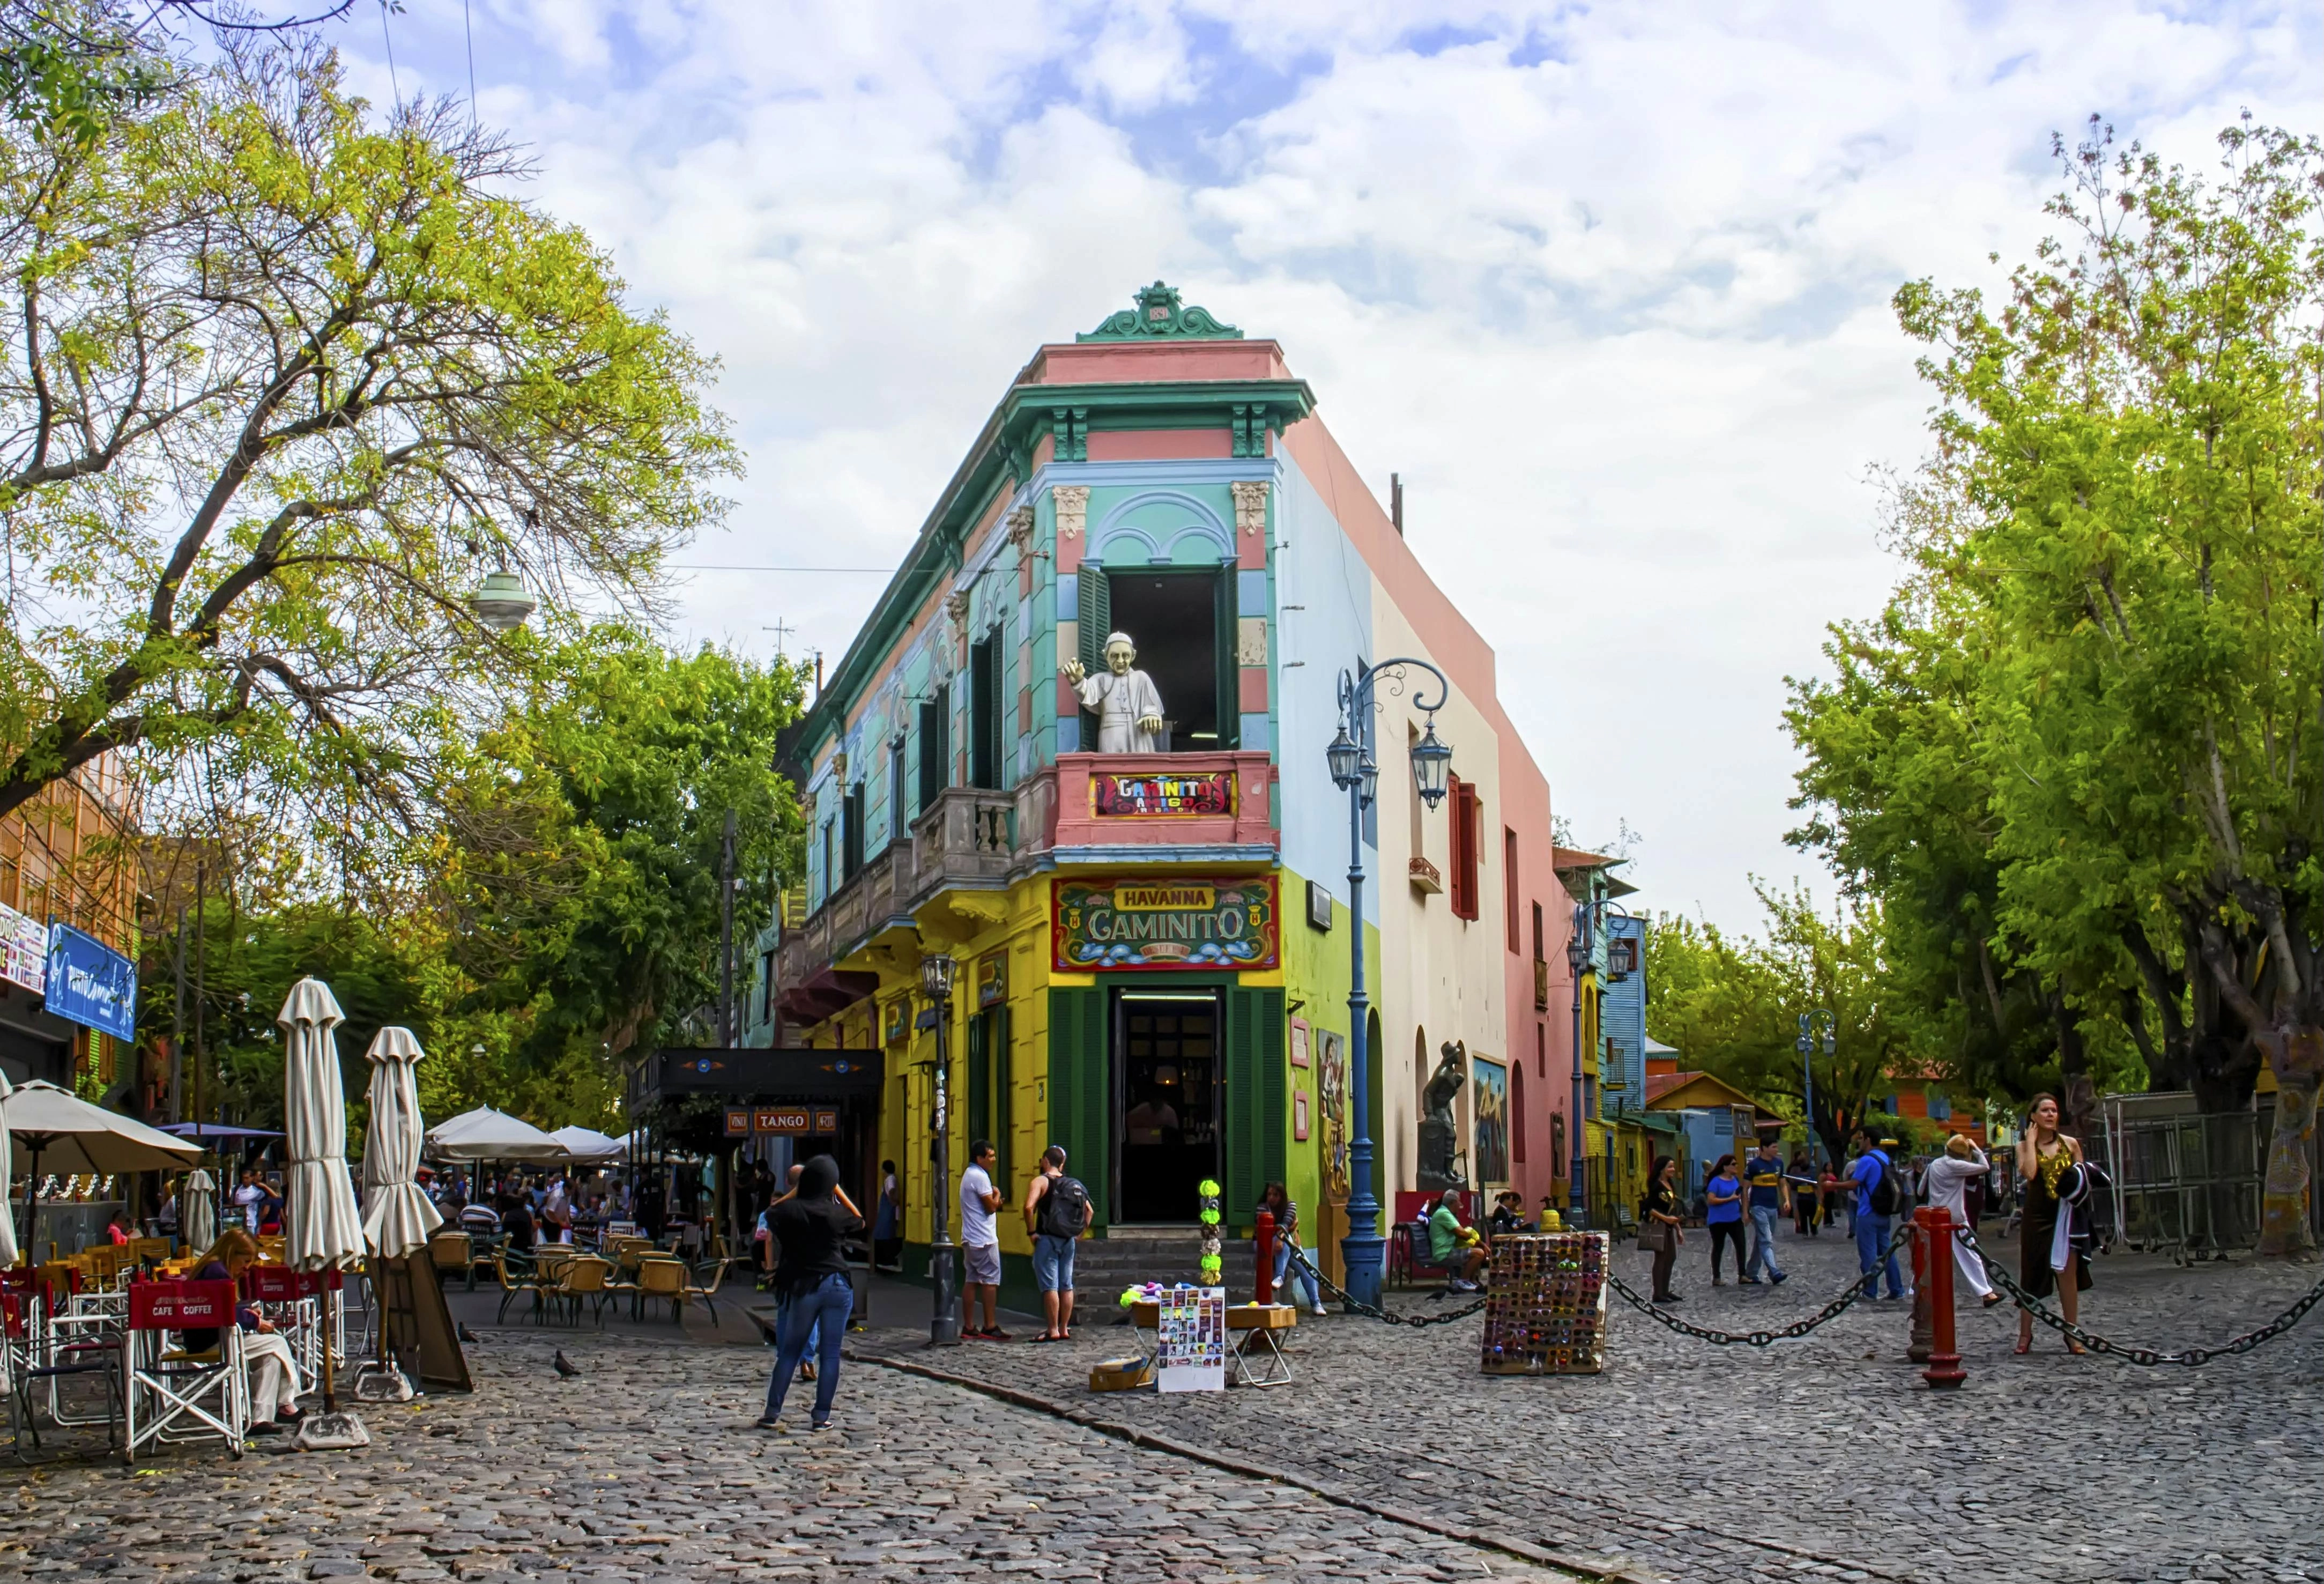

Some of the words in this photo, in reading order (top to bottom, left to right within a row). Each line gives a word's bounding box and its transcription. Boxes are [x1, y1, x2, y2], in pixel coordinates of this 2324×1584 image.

[1119, 779, 1212, 797] CAMINITO
[1137, 797, 1194, 808] AMIGO
[1124, 890, 1207, 906] HAVANNA
[1088, 908, 1244, 941] CAMINITO
[761, 1116, 804, 1128] TANGO
[153, 1307, 173, 1316] CAFE
[183, 1305, 212, 1315] COFFEE
